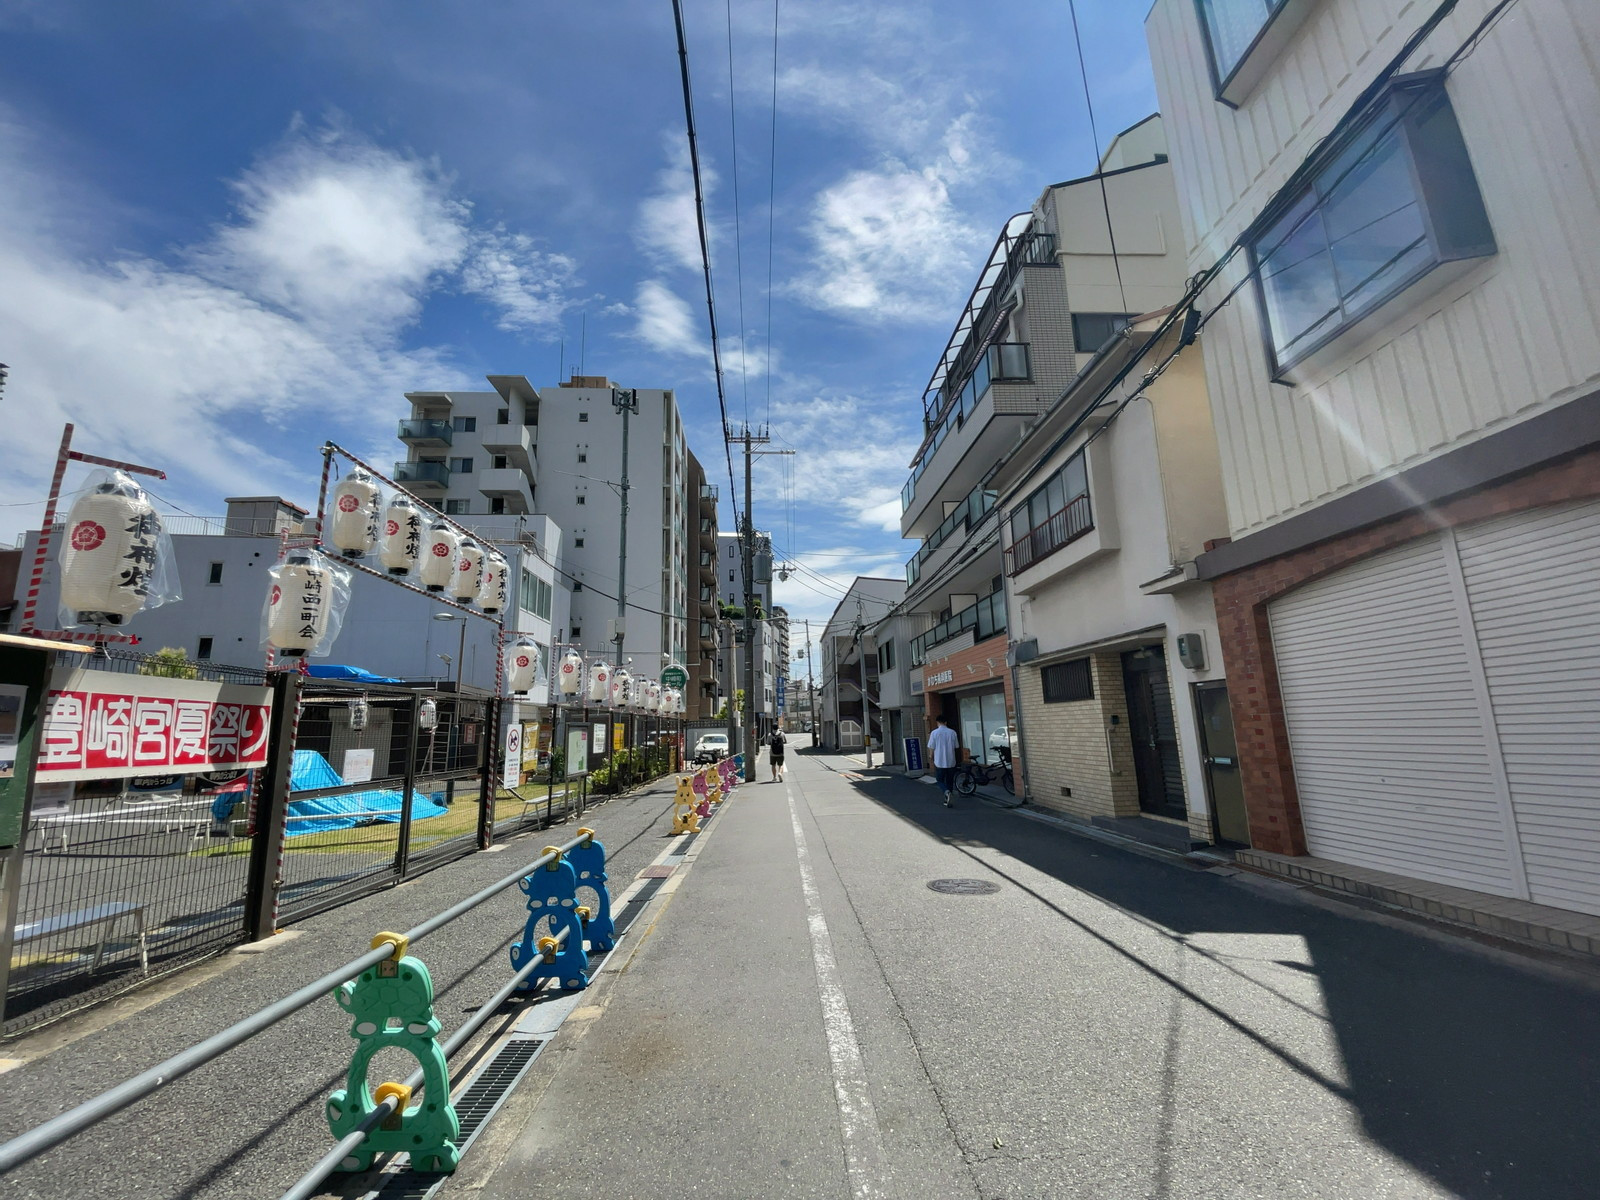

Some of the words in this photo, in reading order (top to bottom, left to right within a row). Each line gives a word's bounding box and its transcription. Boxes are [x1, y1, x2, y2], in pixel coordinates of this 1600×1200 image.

[298, 569, 323, 639] 中崎西一町会
[38, 694, 268, 763] 豊崎宮夏祭り
